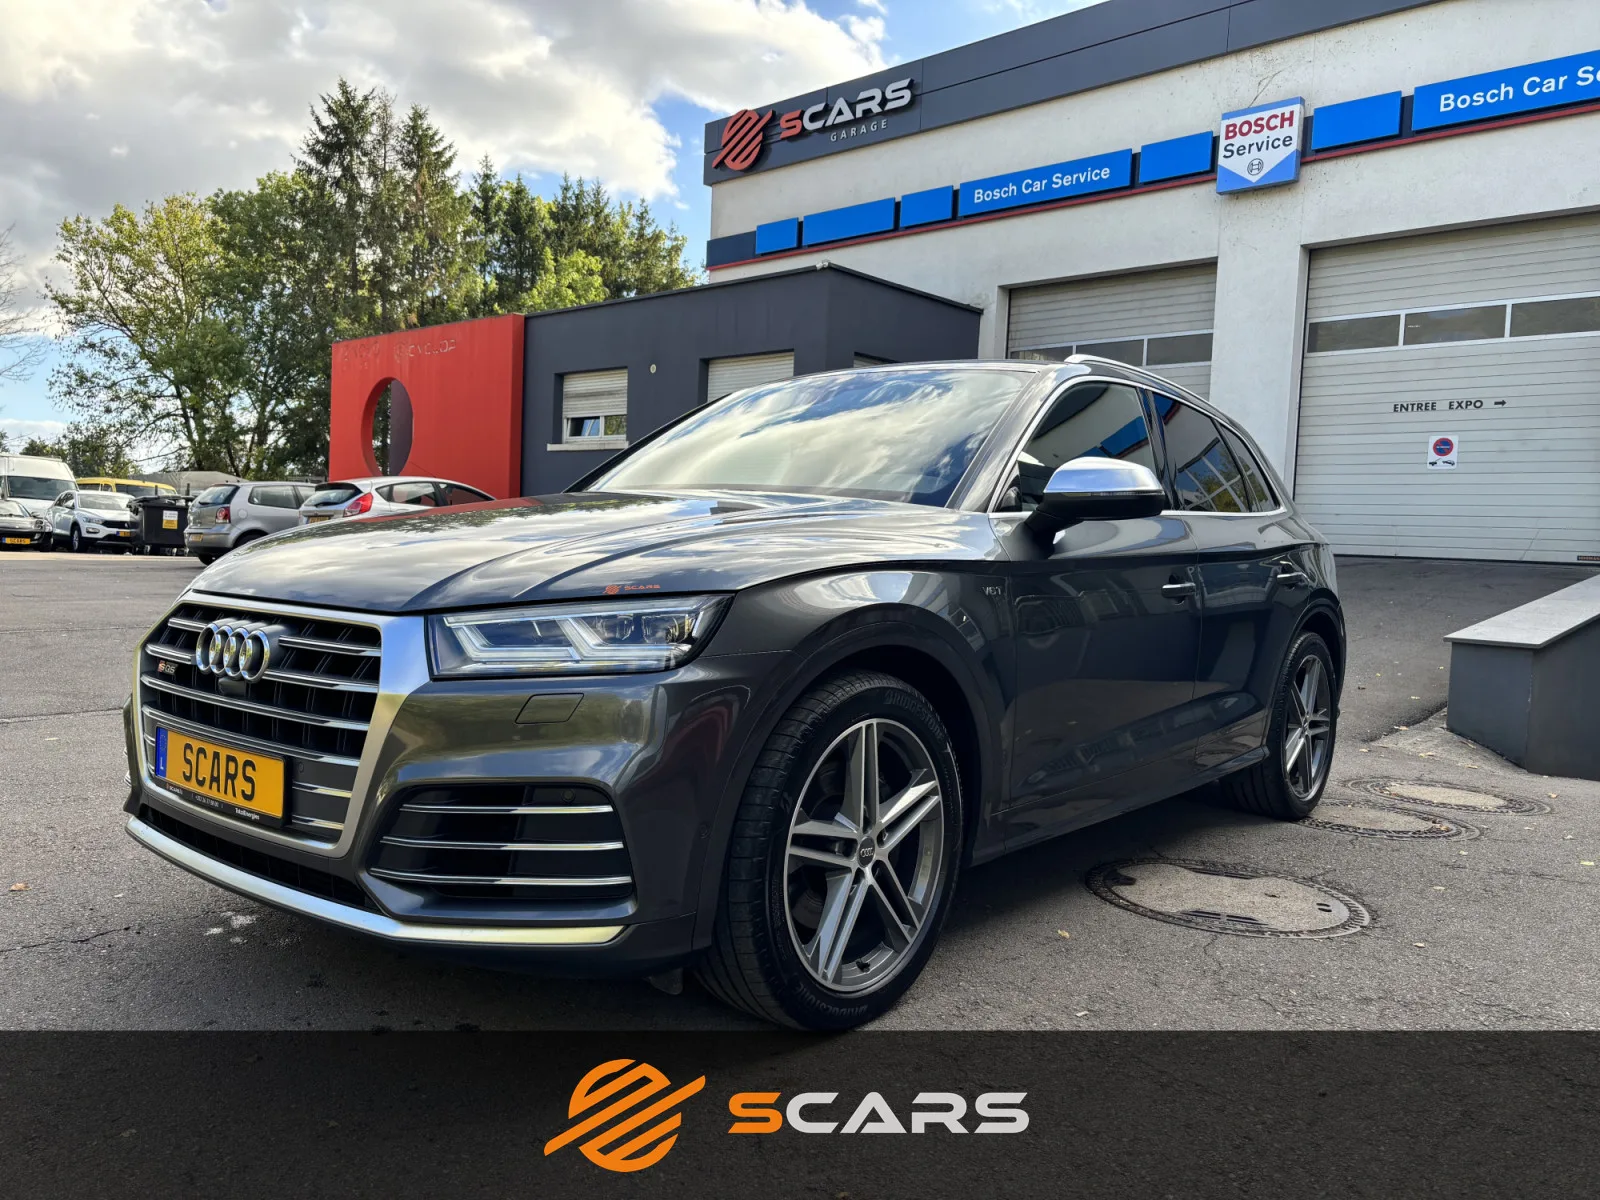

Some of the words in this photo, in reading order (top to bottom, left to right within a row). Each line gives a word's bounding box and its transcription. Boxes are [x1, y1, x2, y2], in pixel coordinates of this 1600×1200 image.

[779, 77, 912, 139] SCARS
[1439, 83, 1514, 113] Bosch
[1523, 75, 1568, 96] Car
[830, 119, 888, 142] GARAGE
[1224, 110, 1294, 141] BOSCH
[1222, 135, 1293, 159] Service
[974, 183, 1017, 204] Bosch
[1022, 179, 1047, 194] Car
[1051, 167, 1111, 188] Service
[1393, 402, 1437, 413] ENTREE
[1448, 400, 1484, 410] EXPO
[182, 742, 257, 802] SCARS
